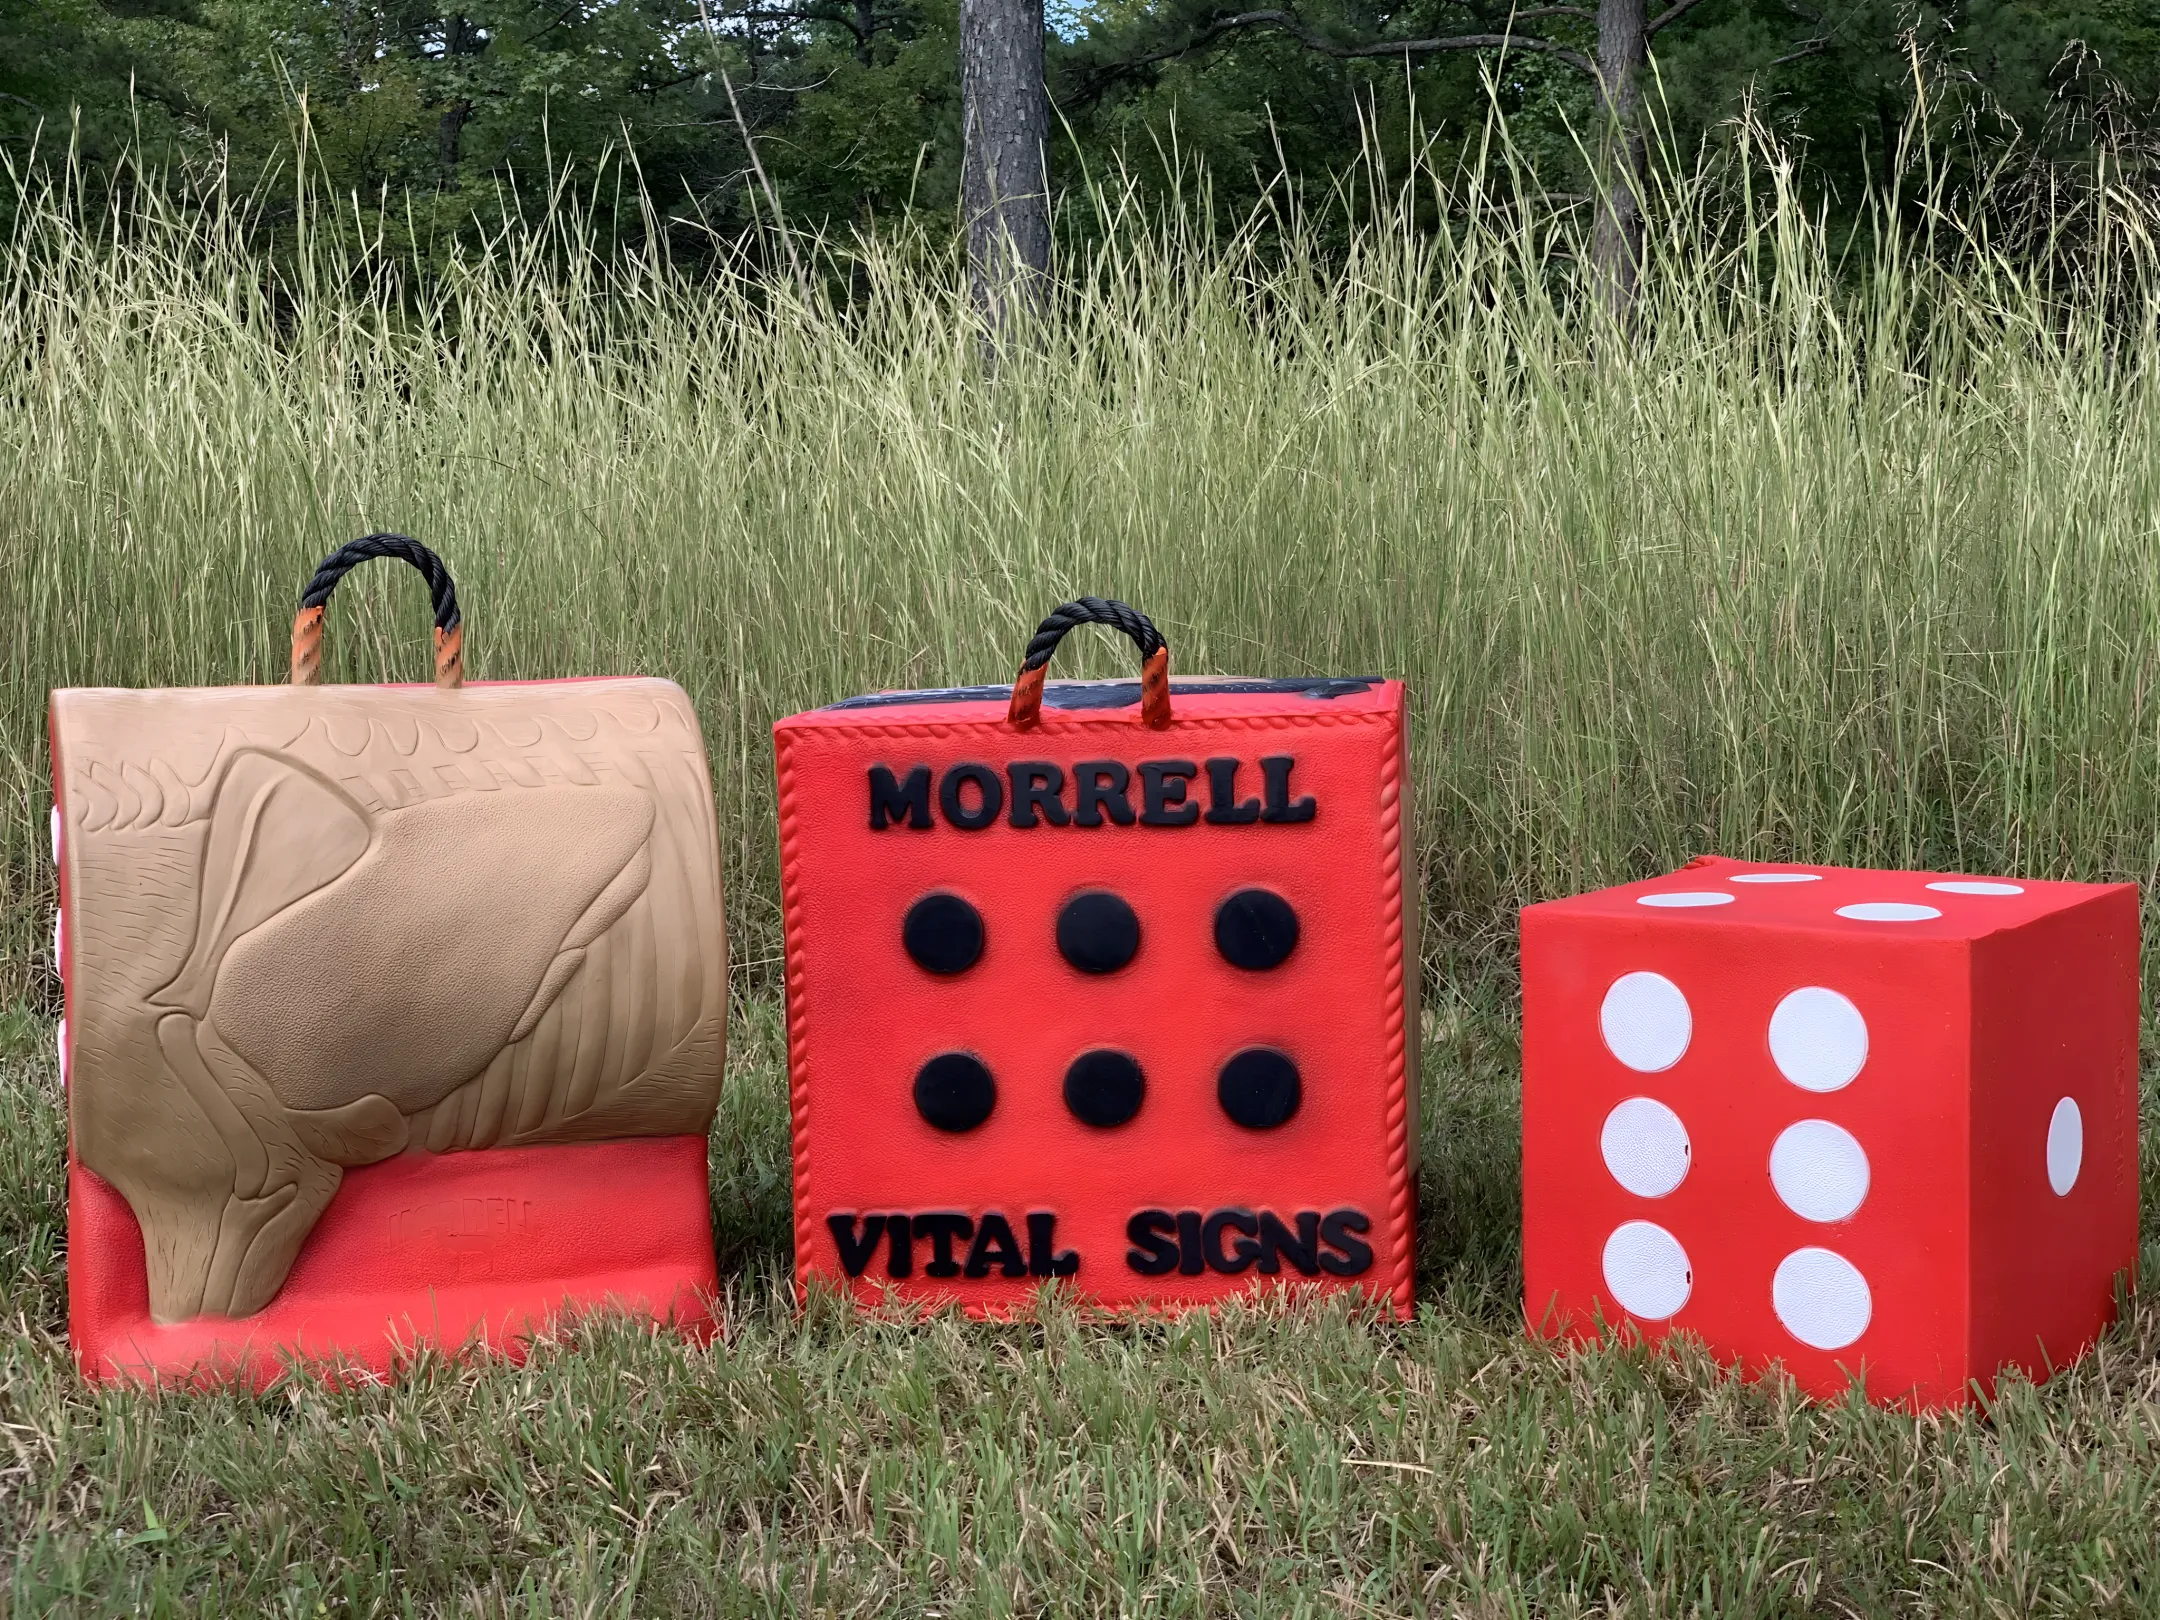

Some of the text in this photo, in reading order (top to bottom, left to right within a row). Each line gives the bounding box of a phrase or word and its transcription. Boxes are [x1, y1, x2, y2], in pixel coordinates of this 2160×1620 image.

[868, 755, 1317, 829] MORRELL
[825, 1208, 1374, 1278] VITAL SIGNS
